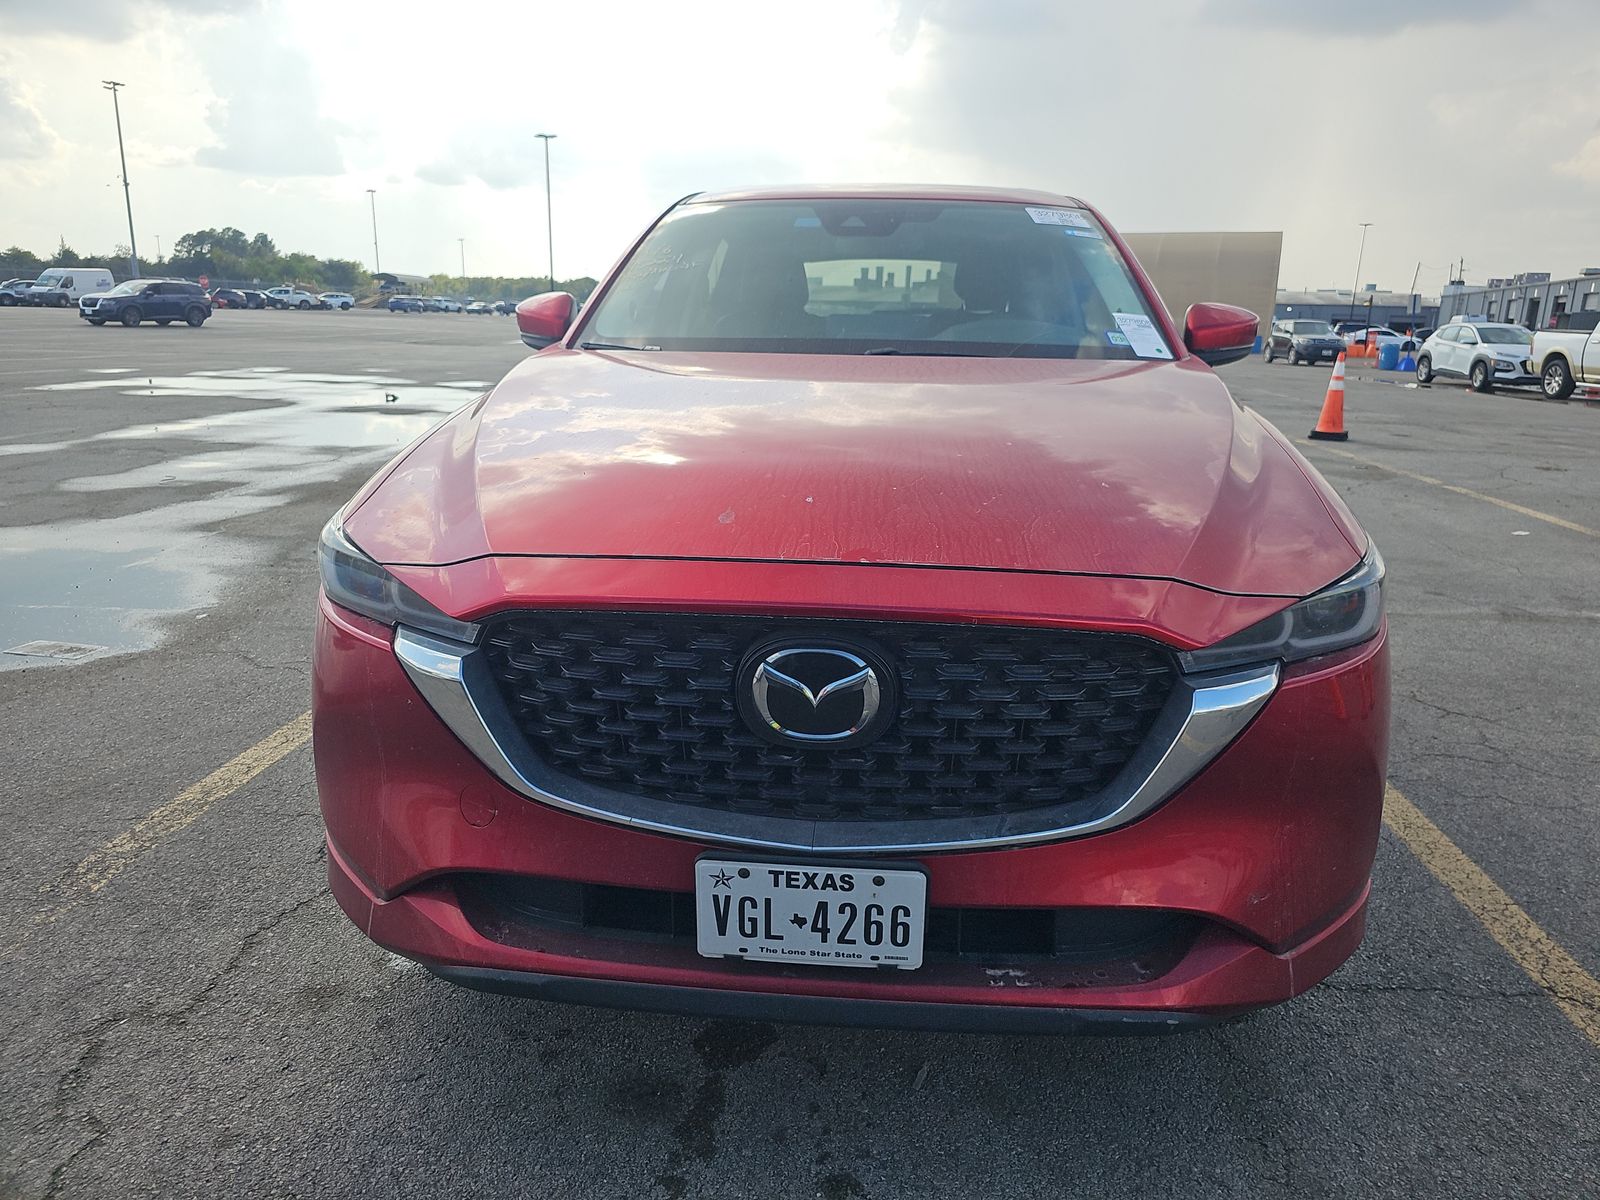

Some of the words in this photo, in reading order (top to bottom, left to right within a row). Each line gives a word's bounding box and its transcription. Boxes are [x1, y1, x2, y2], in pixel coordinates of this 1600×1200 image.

[768, 869, 855, 892] TEXAS
[712, 893, 784, 941] VGL
[810, 900, 911, 948] 4266
[759, 946, 778, 955] The
[781, 947, 807, 957] Lone
[809, 949, 832, 958] Star
[835, 950, 863, 960] State
